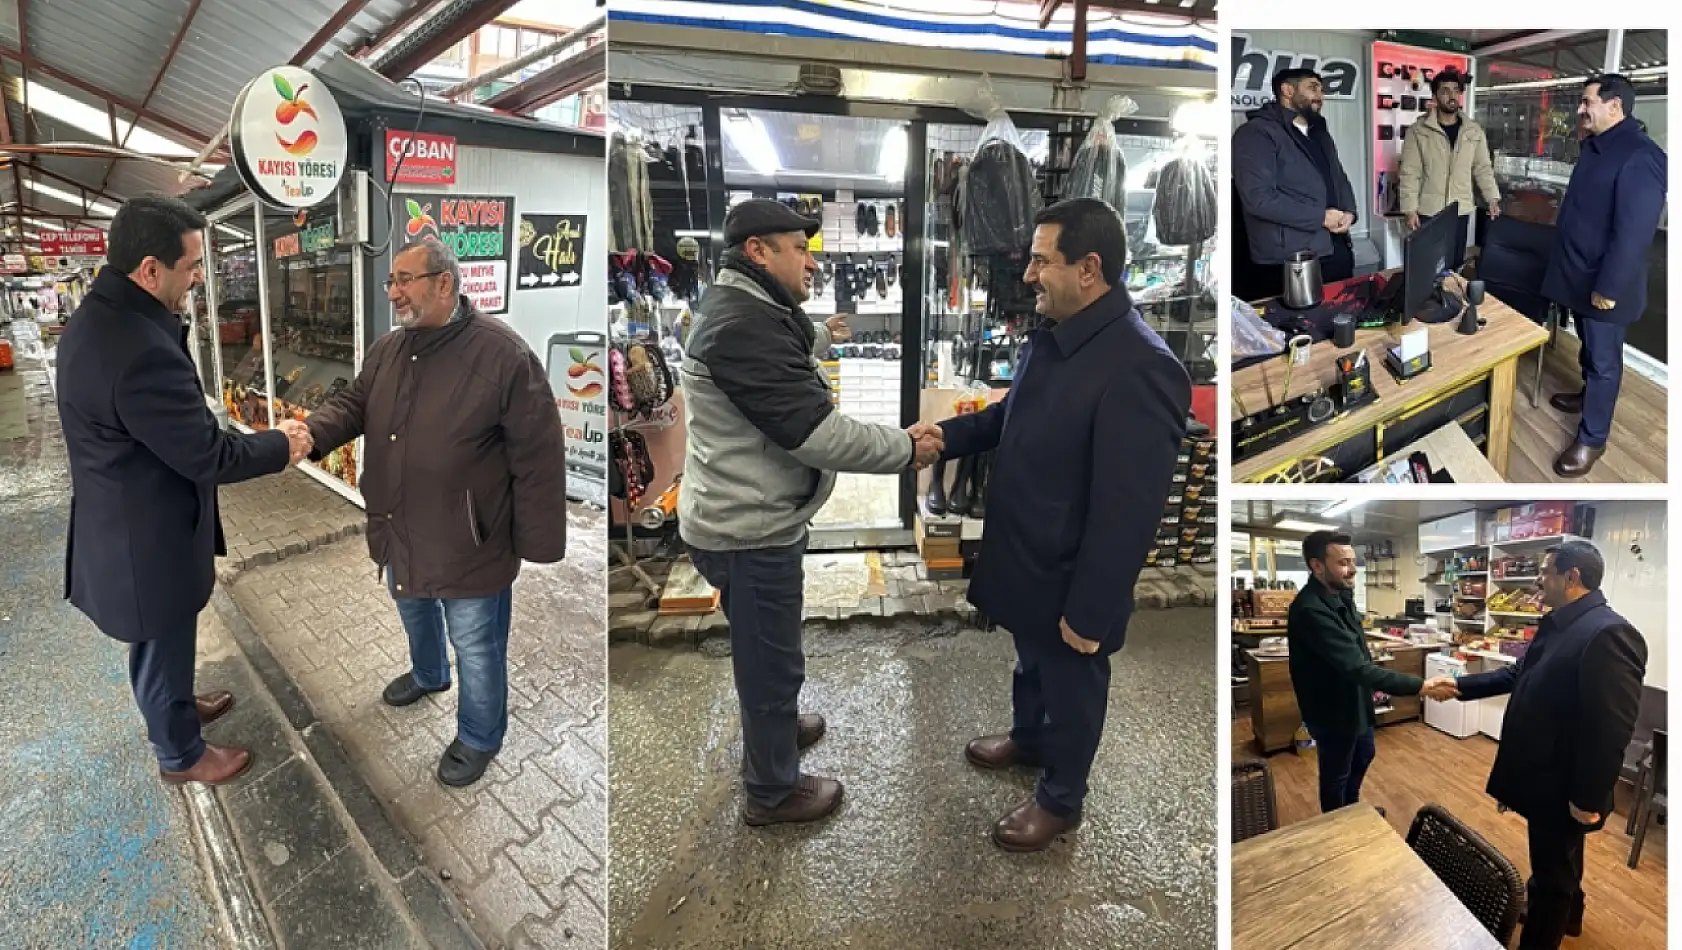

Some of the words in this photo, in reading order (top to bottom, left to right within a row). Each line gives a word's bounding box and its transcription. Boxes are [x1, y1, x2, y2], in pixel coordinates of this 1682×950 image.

[390, 136, 455, 162] ÇOBAN
[258, 159, 296, 177] KAYISI
[297, 158, 336, 178] YÖRESİ
[440, 199, 505, 226] KAYISI
[441, 223, 504, 257] YÖRESİ
